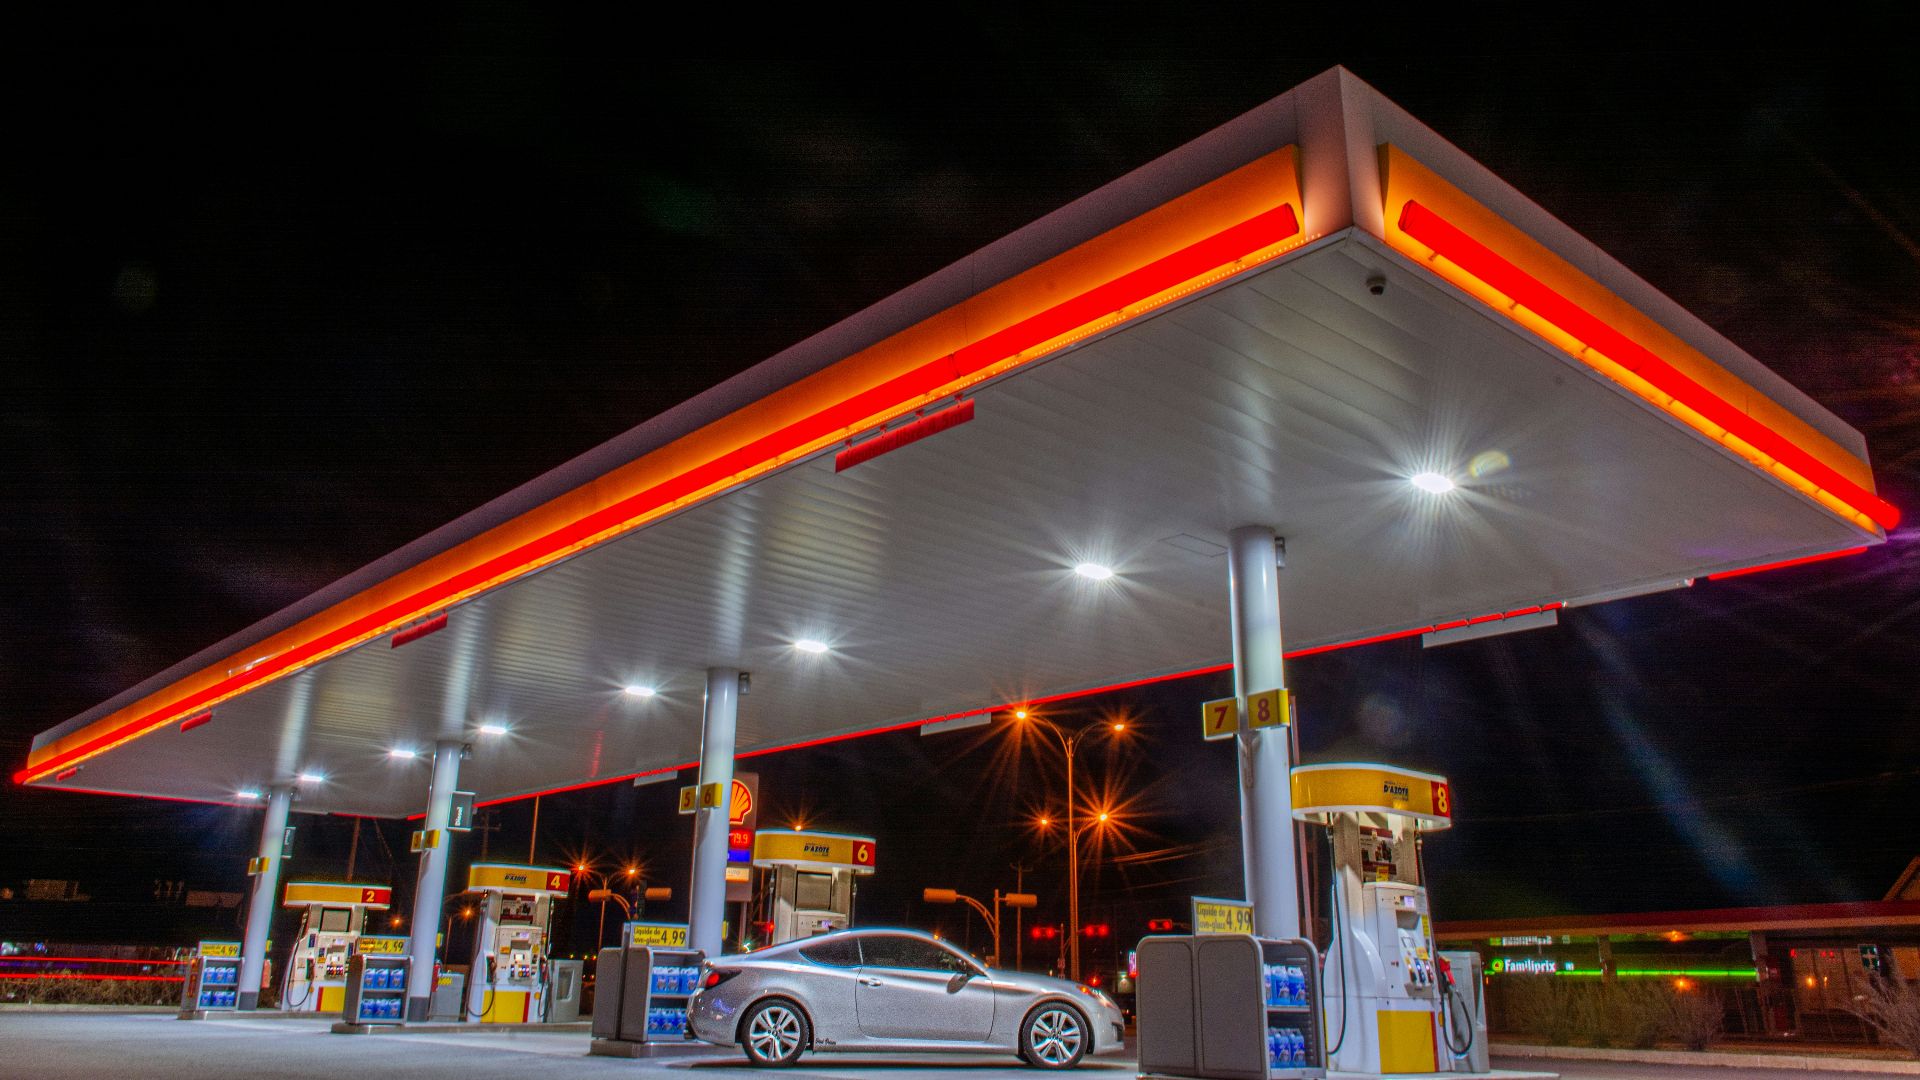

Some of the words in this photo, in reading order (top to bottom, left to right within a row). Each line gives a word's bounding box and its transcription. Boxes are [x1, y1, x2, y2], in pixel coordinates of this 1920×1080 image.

[1214, 705, 1229, 729] 7
[1257, 698, 1270, 722] 8
[683, 791, 691, 807] 5
[704, 793, 712, 805] 6
[1437, 786, 1448, 813] 8
[857, 843, 869, 863] 6
[550, 874, 561, 889] 4
[366, 890, 375, 902] 2
[1504, 959, 1556, 975] Familiprix
